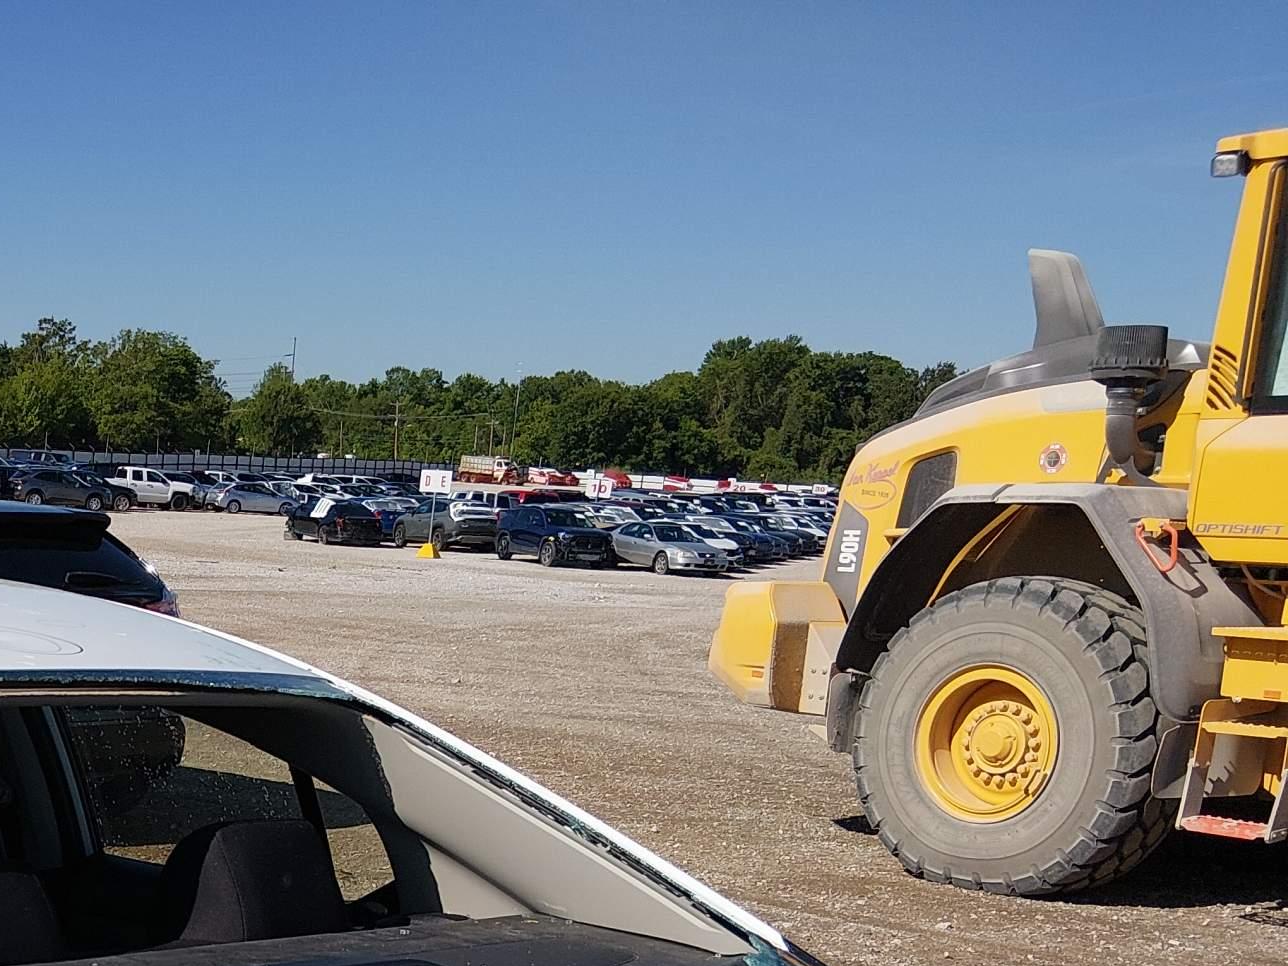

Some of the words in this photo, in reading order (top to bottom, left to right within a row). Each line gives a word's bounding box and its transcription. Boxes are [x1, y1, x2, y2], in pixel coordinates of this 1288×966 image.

[425, 475, 431, 487] D
[441, 476, 447, 488] E
[592, 484, 607, 494] 10
[1196, 523, 1285, 535] OPTISHIFT
[837, 529, 862, 573] L90H
